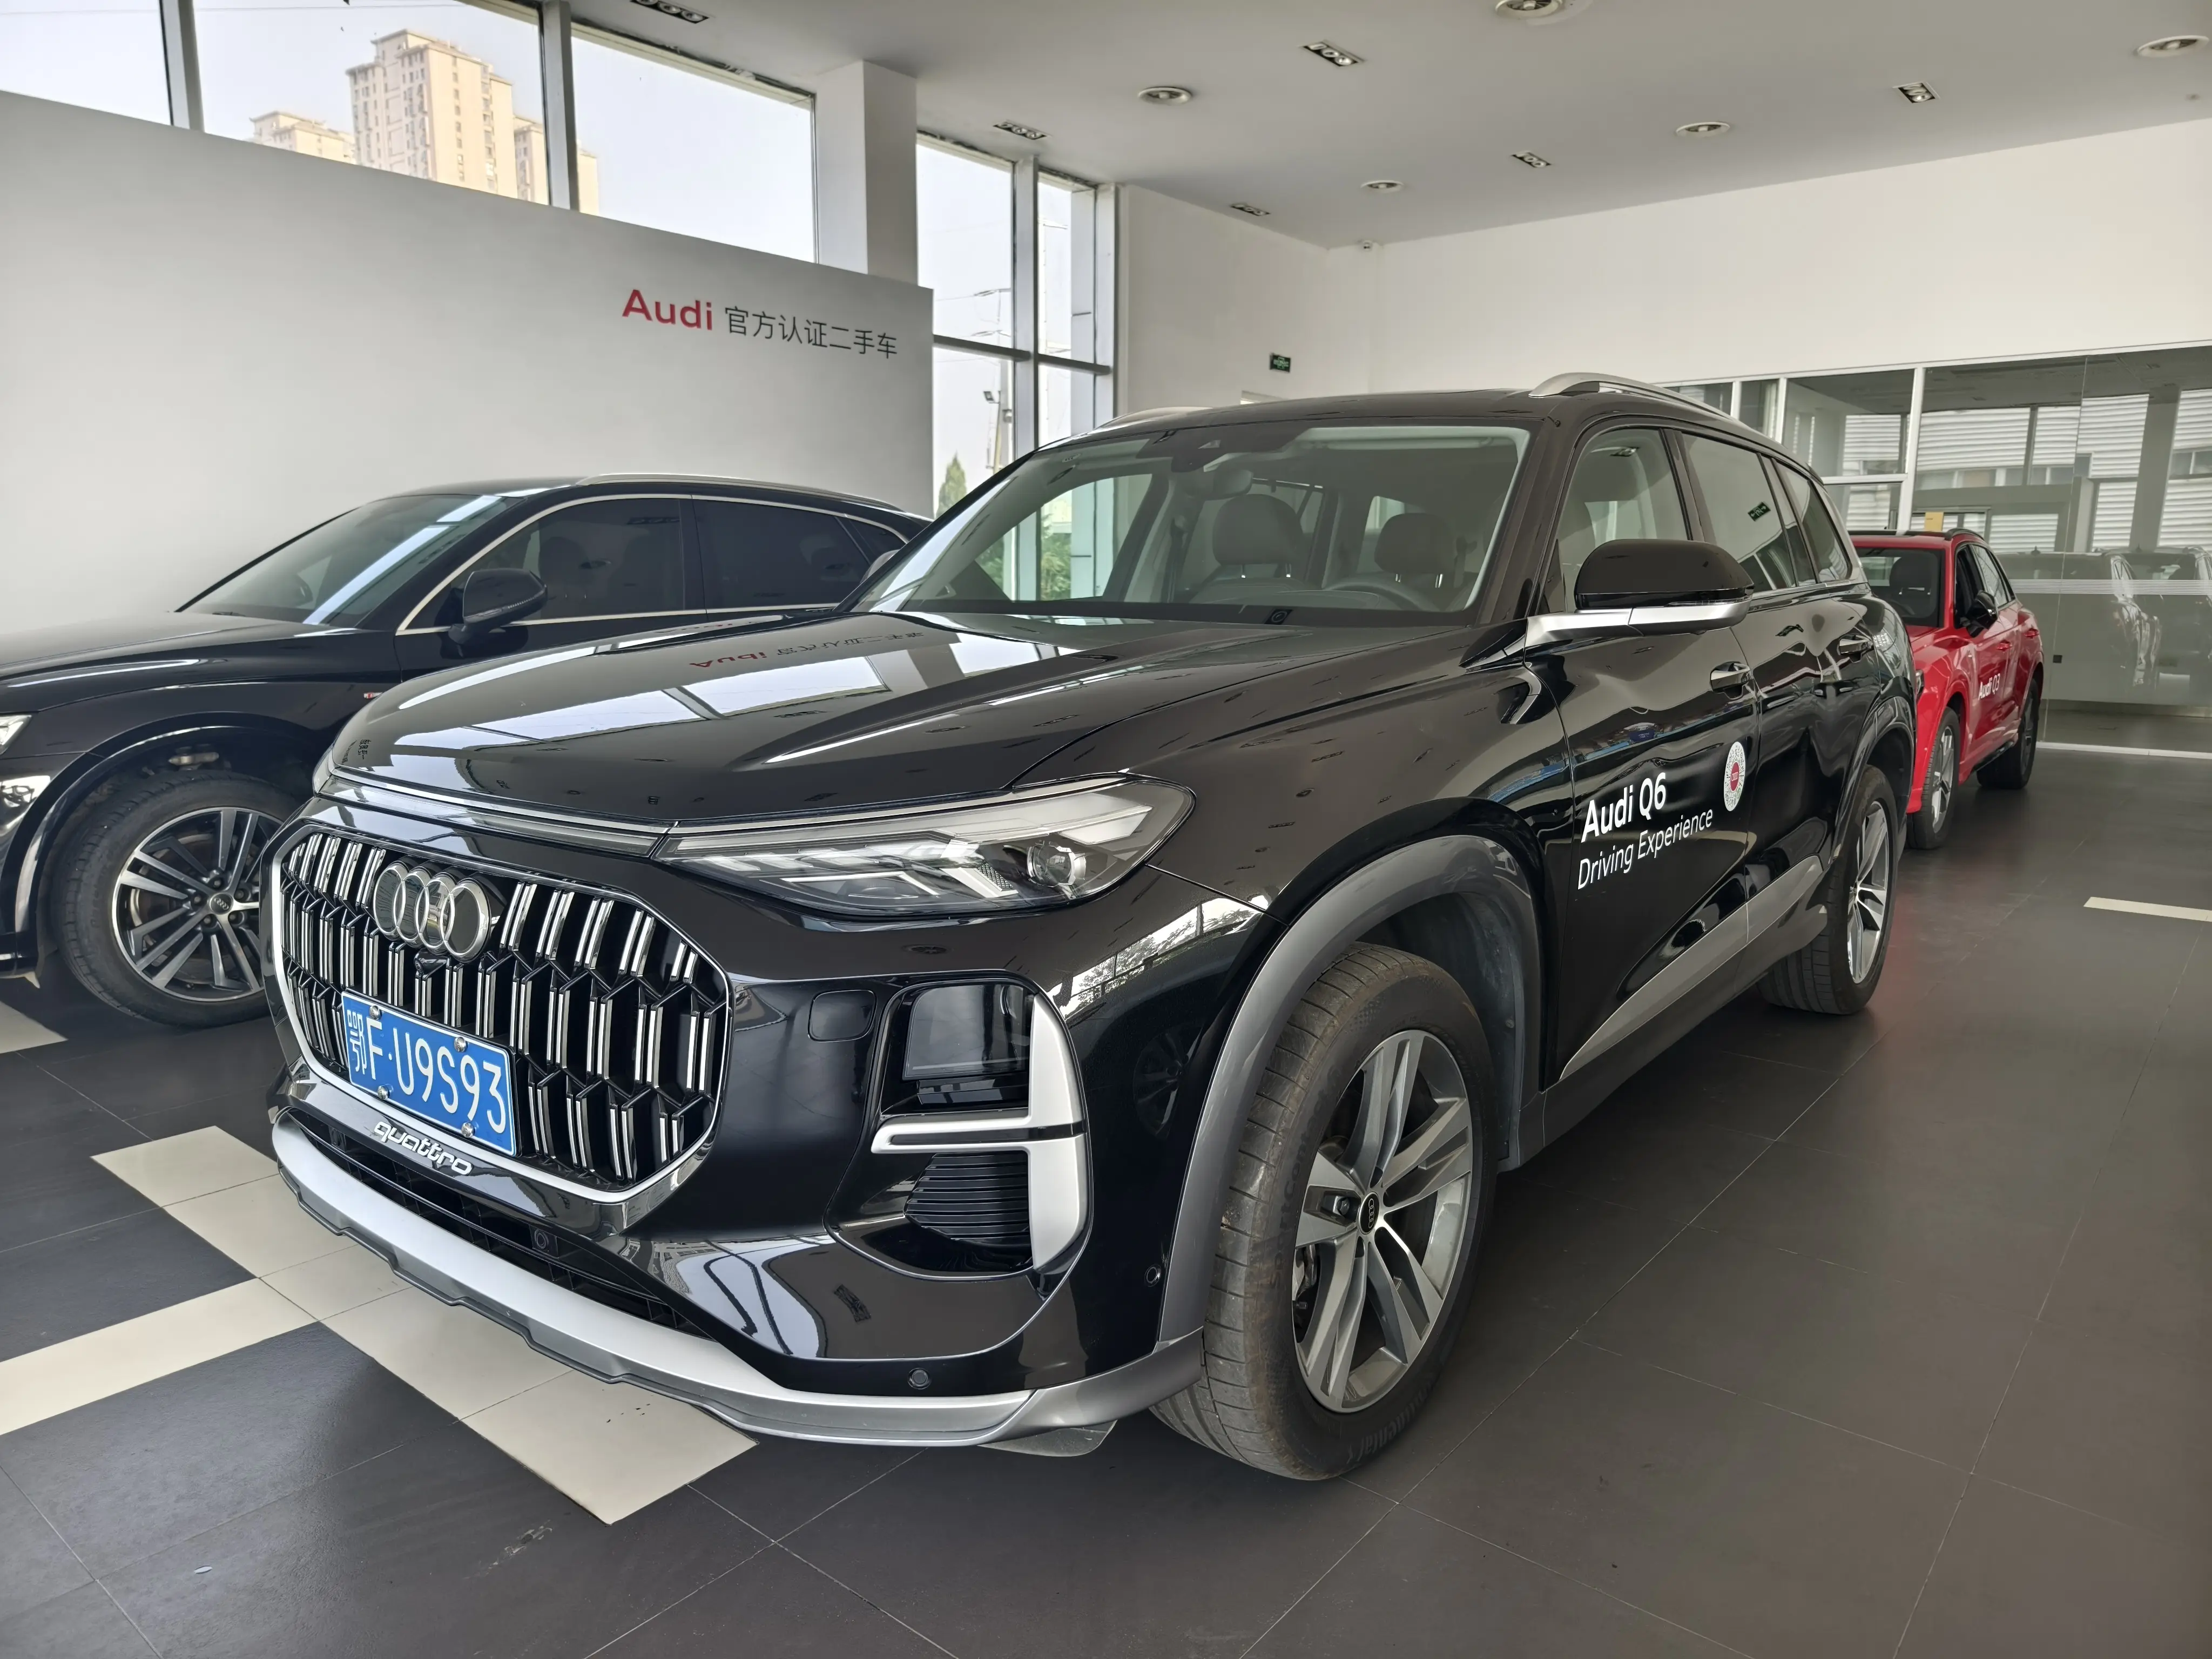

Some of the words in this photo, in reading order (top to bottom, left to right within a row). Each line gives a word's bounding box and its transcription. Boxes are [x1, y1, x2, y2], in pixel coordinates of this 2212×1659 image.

[622, 289, 713, 331] Audi
[725, 306, 898, 359] 官方认证二手车
[1978, 677, 1993, 700] Audi
[1992, 673, 2000, 695] Q3
[1581, 784, 1633, 843] Audi
[1639, 772, 1666, 820] Q6
[1577, 843, 1634, 890] Driving
[1637, 809, 1713, 859] Experience
[374, 1121, 474, 1176] quattro
